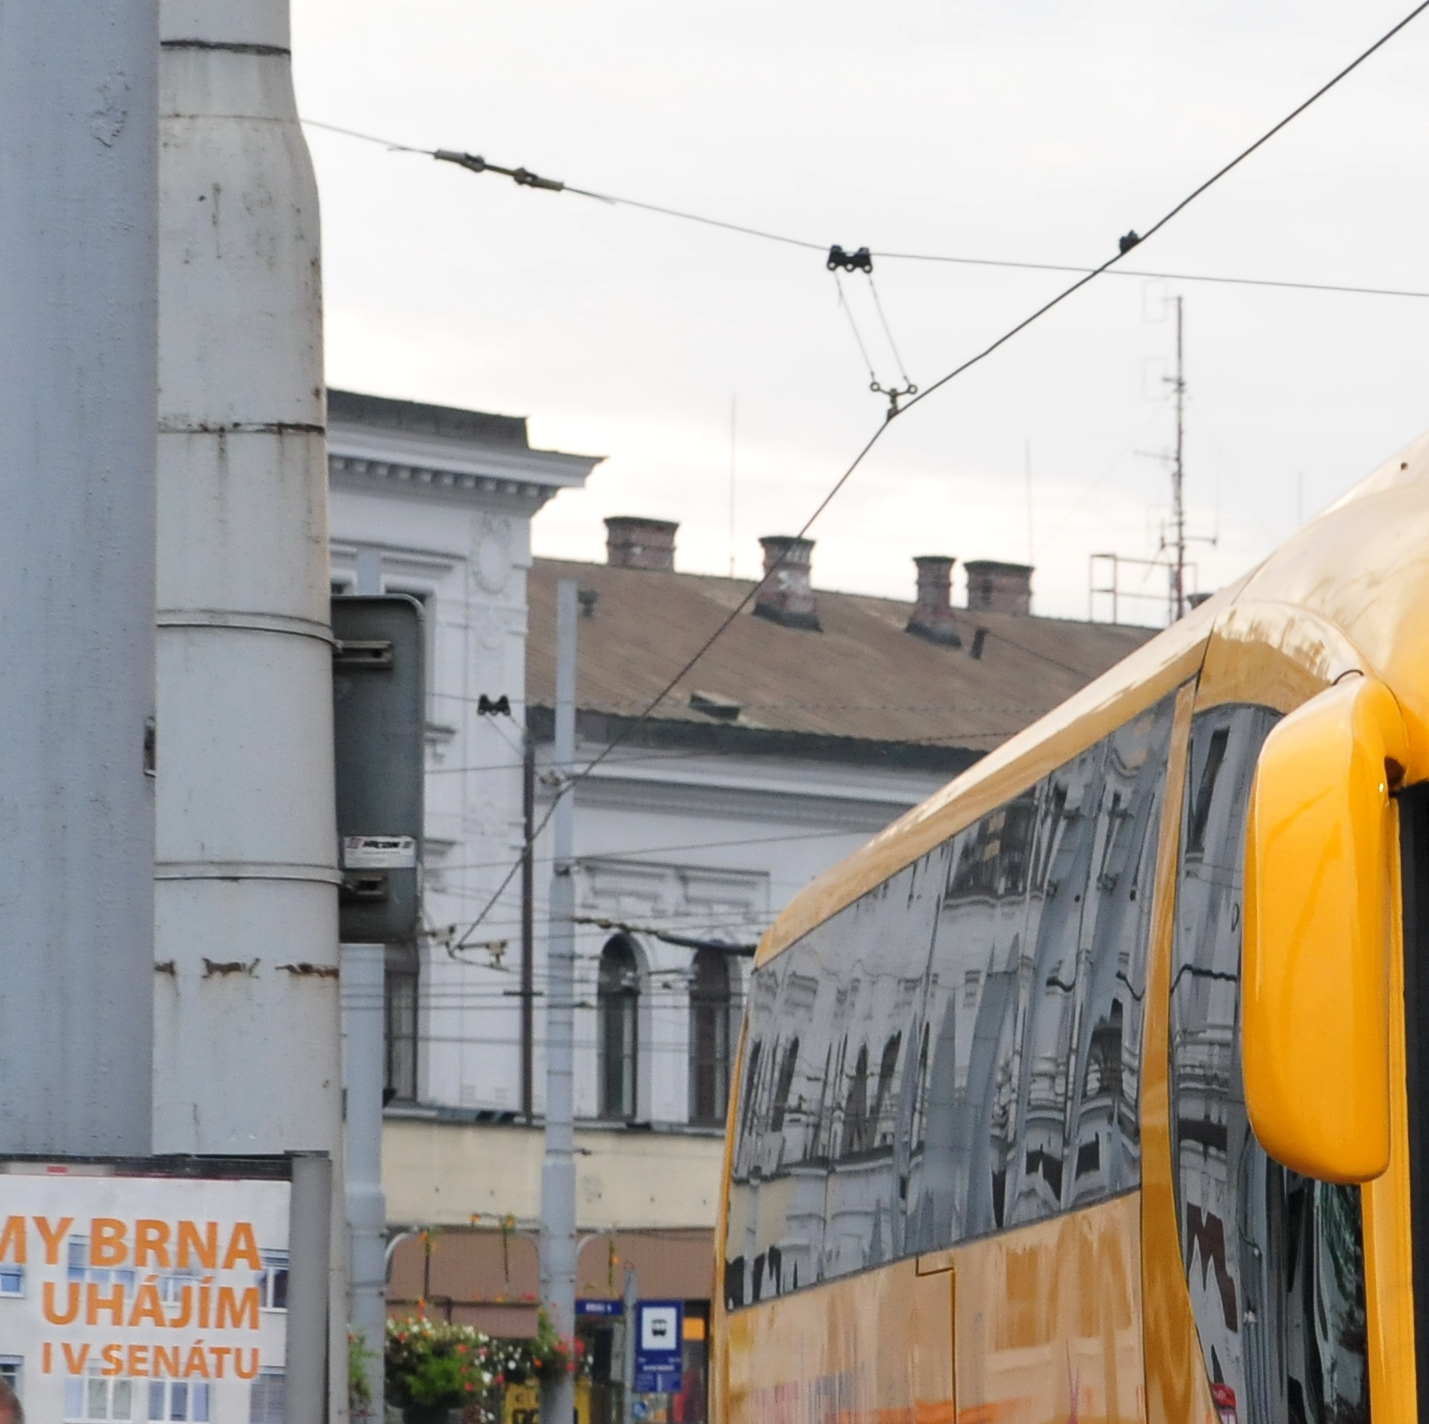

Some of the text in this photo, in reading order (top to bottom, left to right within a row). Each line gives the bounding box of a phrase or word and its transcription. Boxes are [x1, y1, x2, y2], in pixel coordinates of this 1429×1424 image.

[90, 1217, 262, 1271] BRNA
[42, 1273, 260, 1330] UHÁJÍM
[42, 1338, 260, 1379] I V SENÁTU
